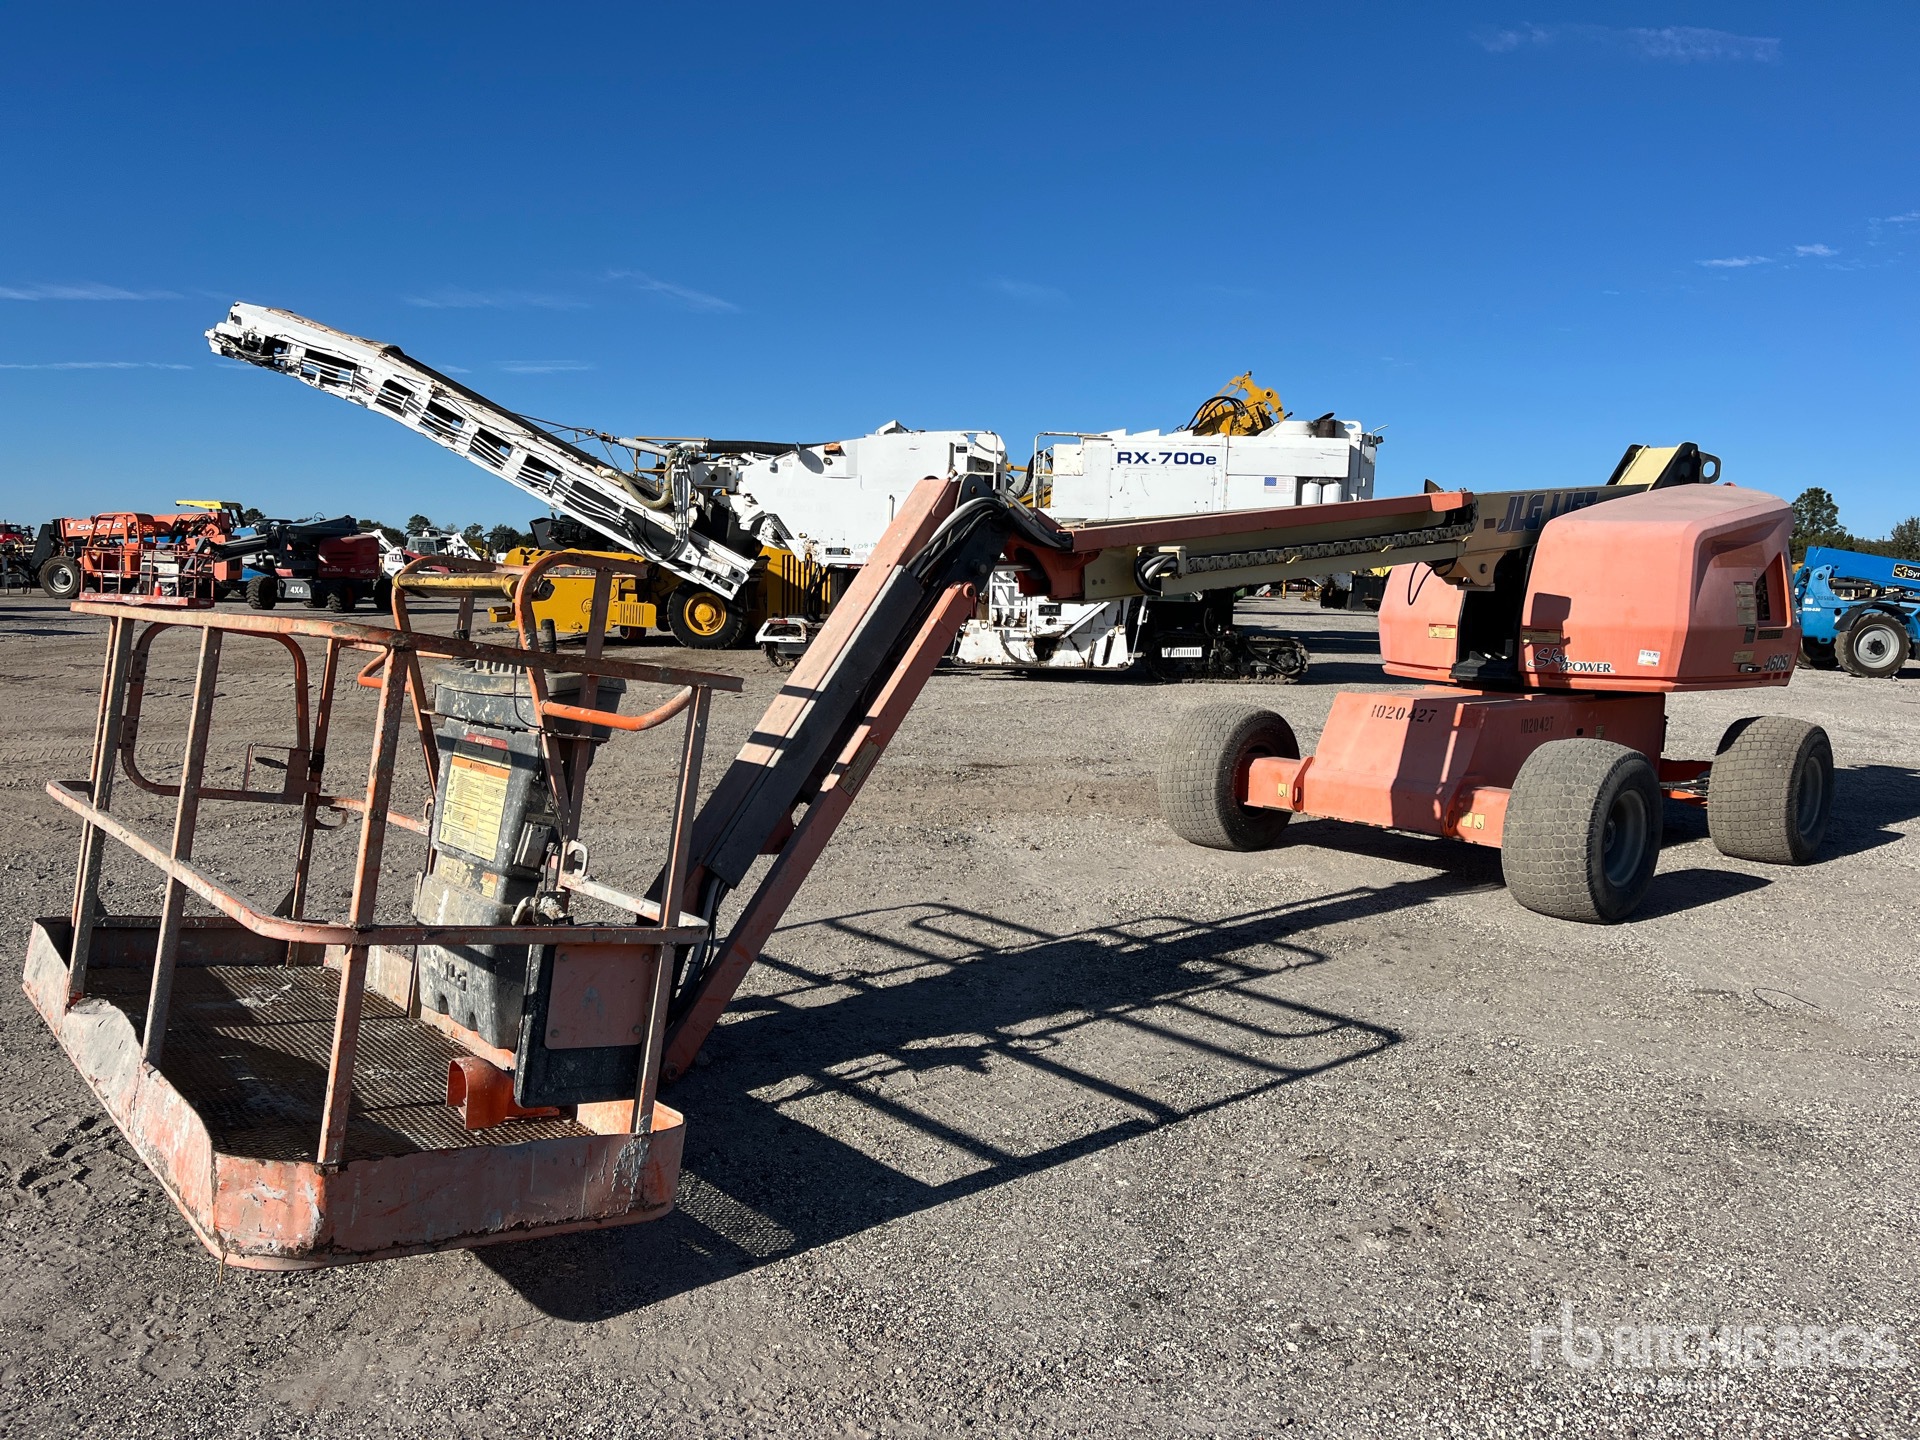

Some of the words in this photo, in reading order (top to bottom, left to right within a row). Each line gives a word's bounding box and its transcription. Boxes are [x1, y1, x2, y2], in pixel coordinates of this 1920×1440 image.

[1117, 451, 1217, 465] RX-700e
[1497, 493, 1547, 533] JLG
[290, 586, 304, 594] 4X4
[1371, 704, 1438, 723] 1020427
[1520, 716, 1554, 734] 1020427
